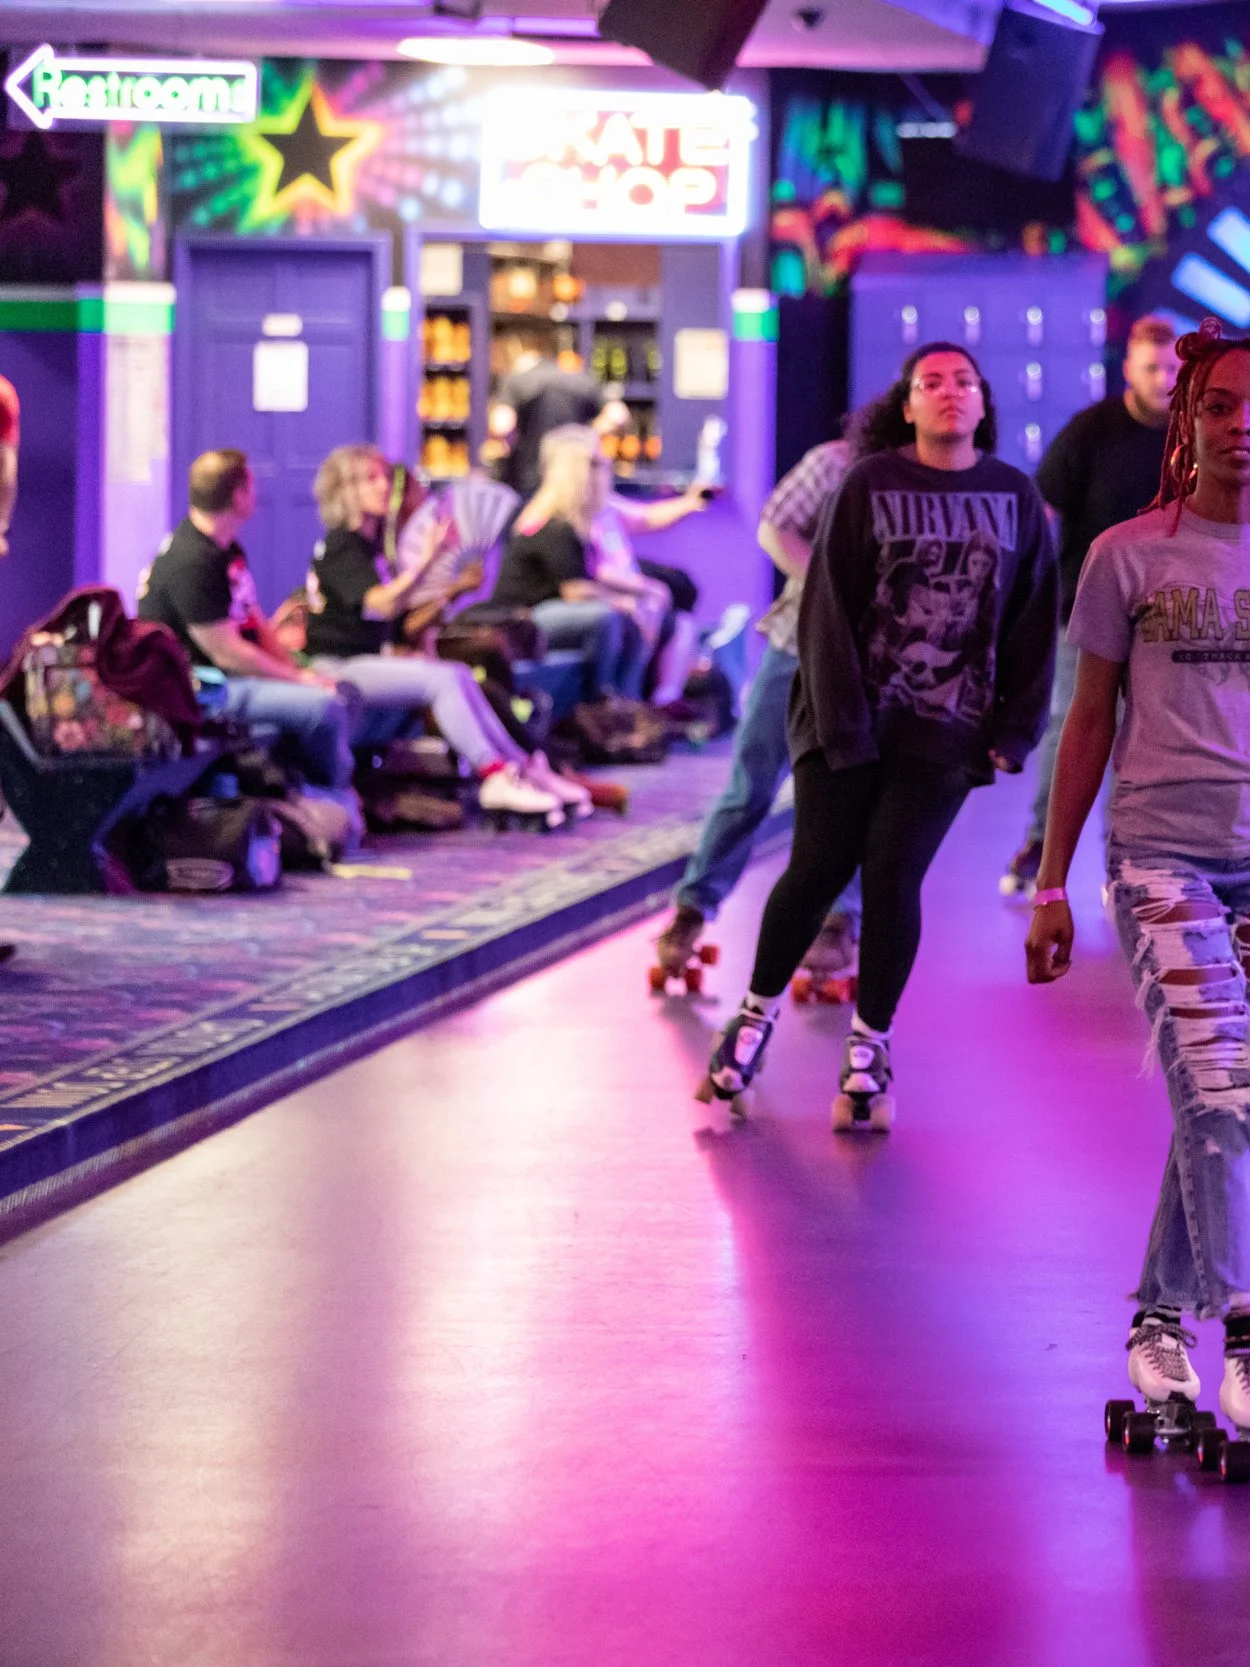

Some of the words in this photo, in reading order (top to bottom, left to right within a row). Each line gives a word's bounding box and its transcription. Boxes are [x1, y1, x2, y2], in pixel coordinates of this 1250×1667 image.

[31, 62, 248, 113] Restrooms
[504, 111, 731, 167] KATE
[871, 490, 1019, 552] NIRVANA
